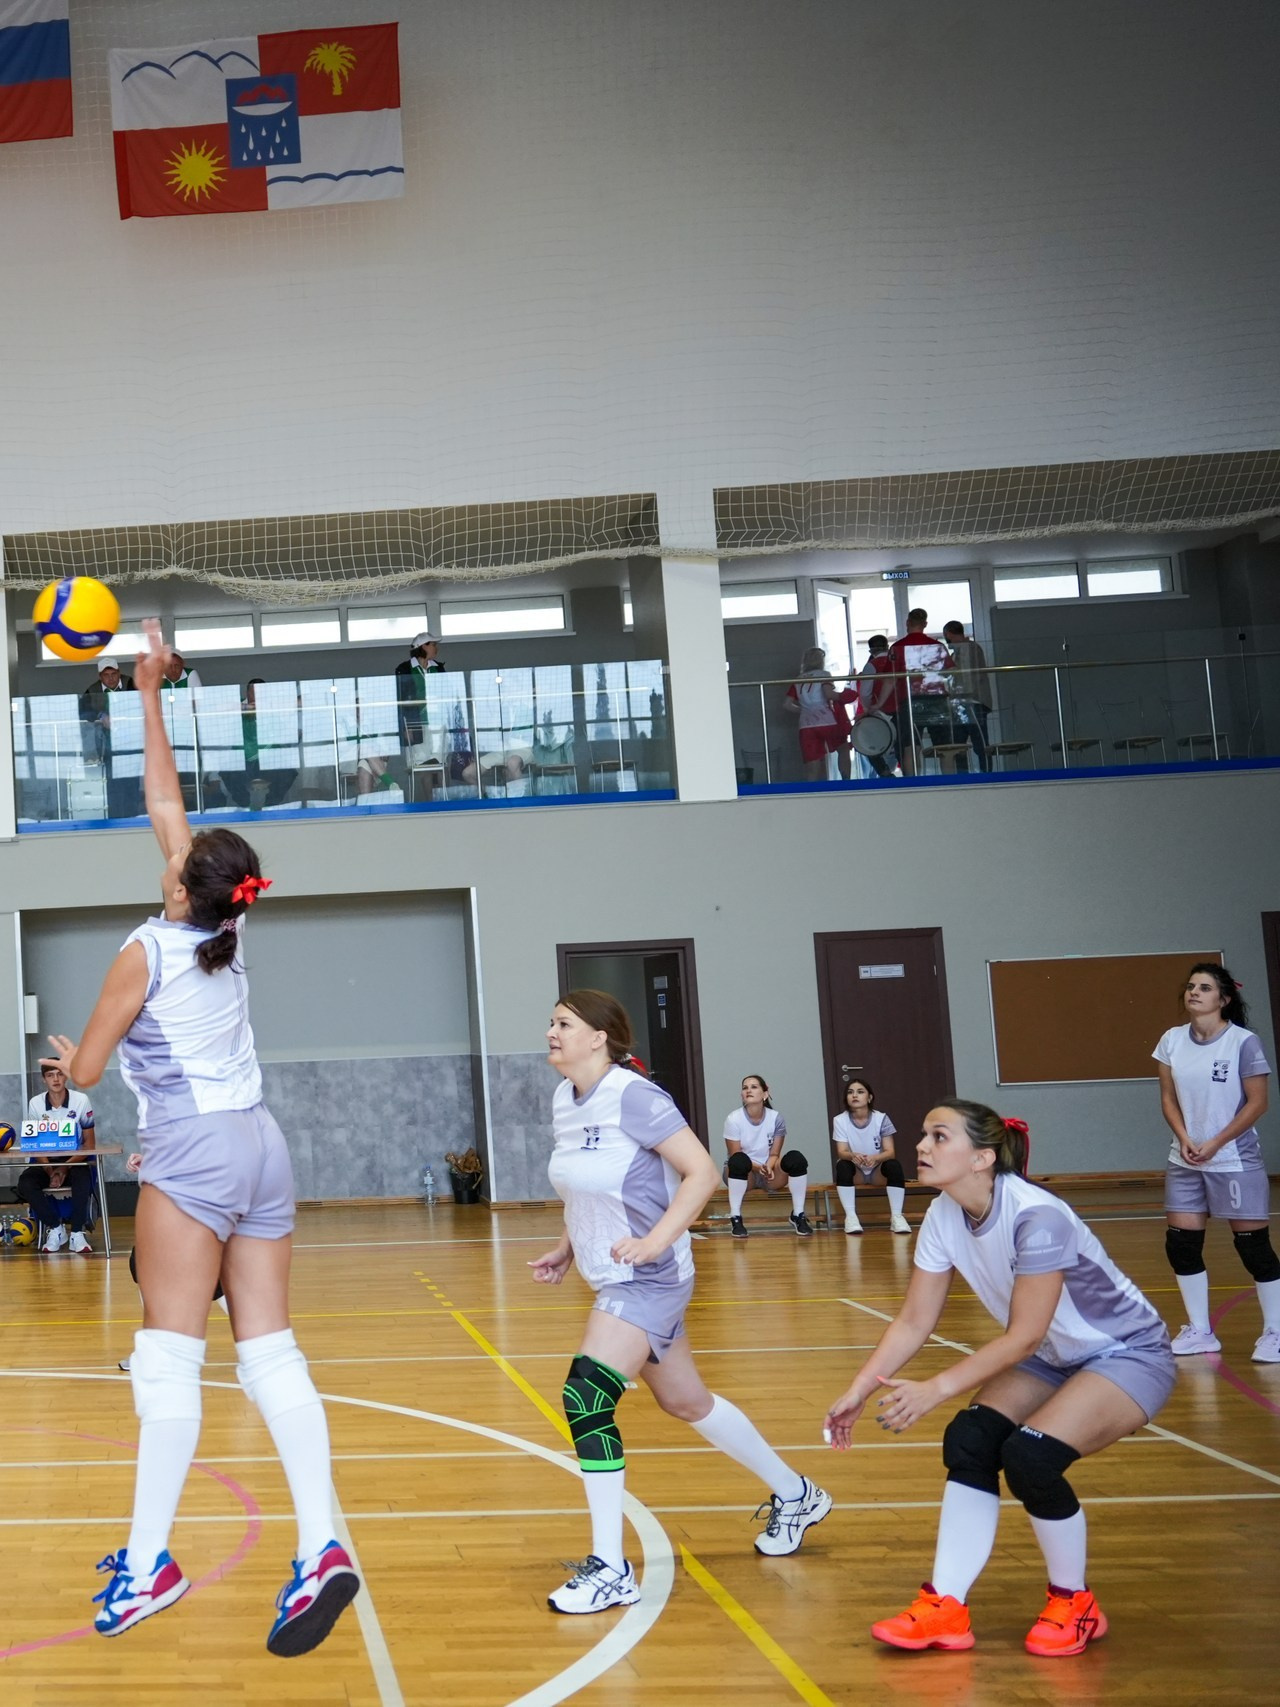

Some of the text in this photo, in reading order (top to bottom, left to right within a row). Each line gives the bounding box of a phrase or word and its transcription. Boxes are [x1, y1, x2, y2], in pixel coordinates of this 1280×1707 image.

[25, 1124, 34, 1136] 3
[62, 1122, 71, 1135] 4
[1229, 1179, 1242, 1210] 9
